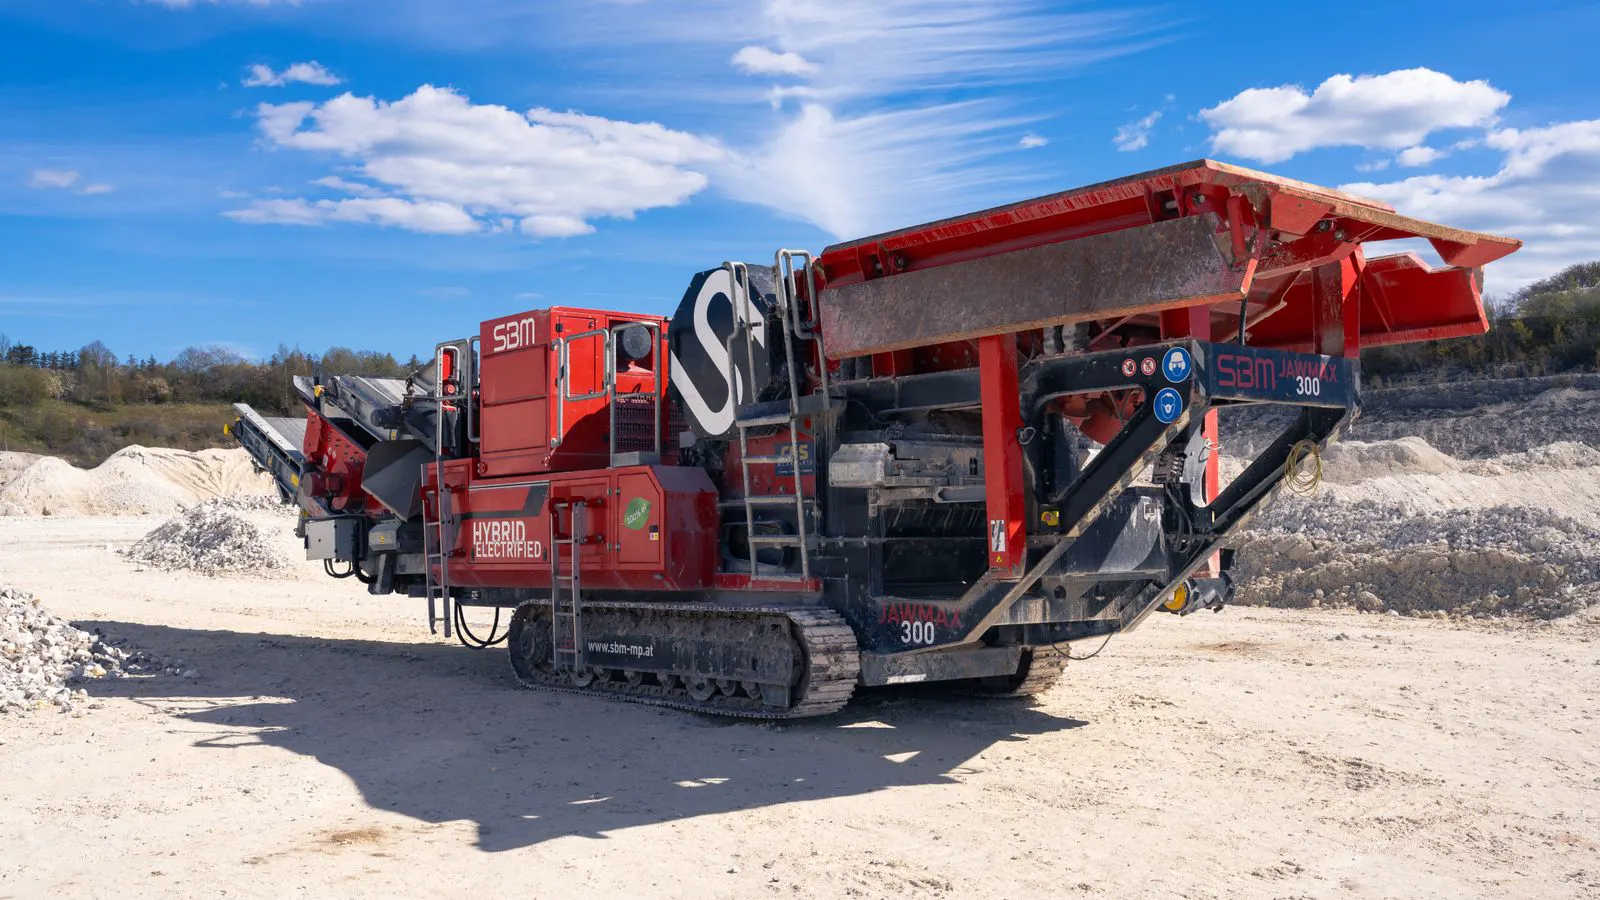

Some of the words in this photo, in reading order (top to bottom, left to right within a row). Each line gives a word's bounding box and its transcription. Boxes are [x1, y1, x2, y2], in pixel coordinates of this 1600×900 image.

[493, 317, 535, 352] SBM
[1217, 354, 1276, 390] SBM
[1279, 358, 1338, 383] JAWMAX
[1296, 376, 1320, 396] 300
[473, 521, 526, 545] HYBRID
[475, 540, 541, 558] ELECTRIFIED
[879, 600, 965, 628] JAWMAX
[900, 620, 935, 645] 300
[587, 641, 654, 659] www.sbm-mp.at
